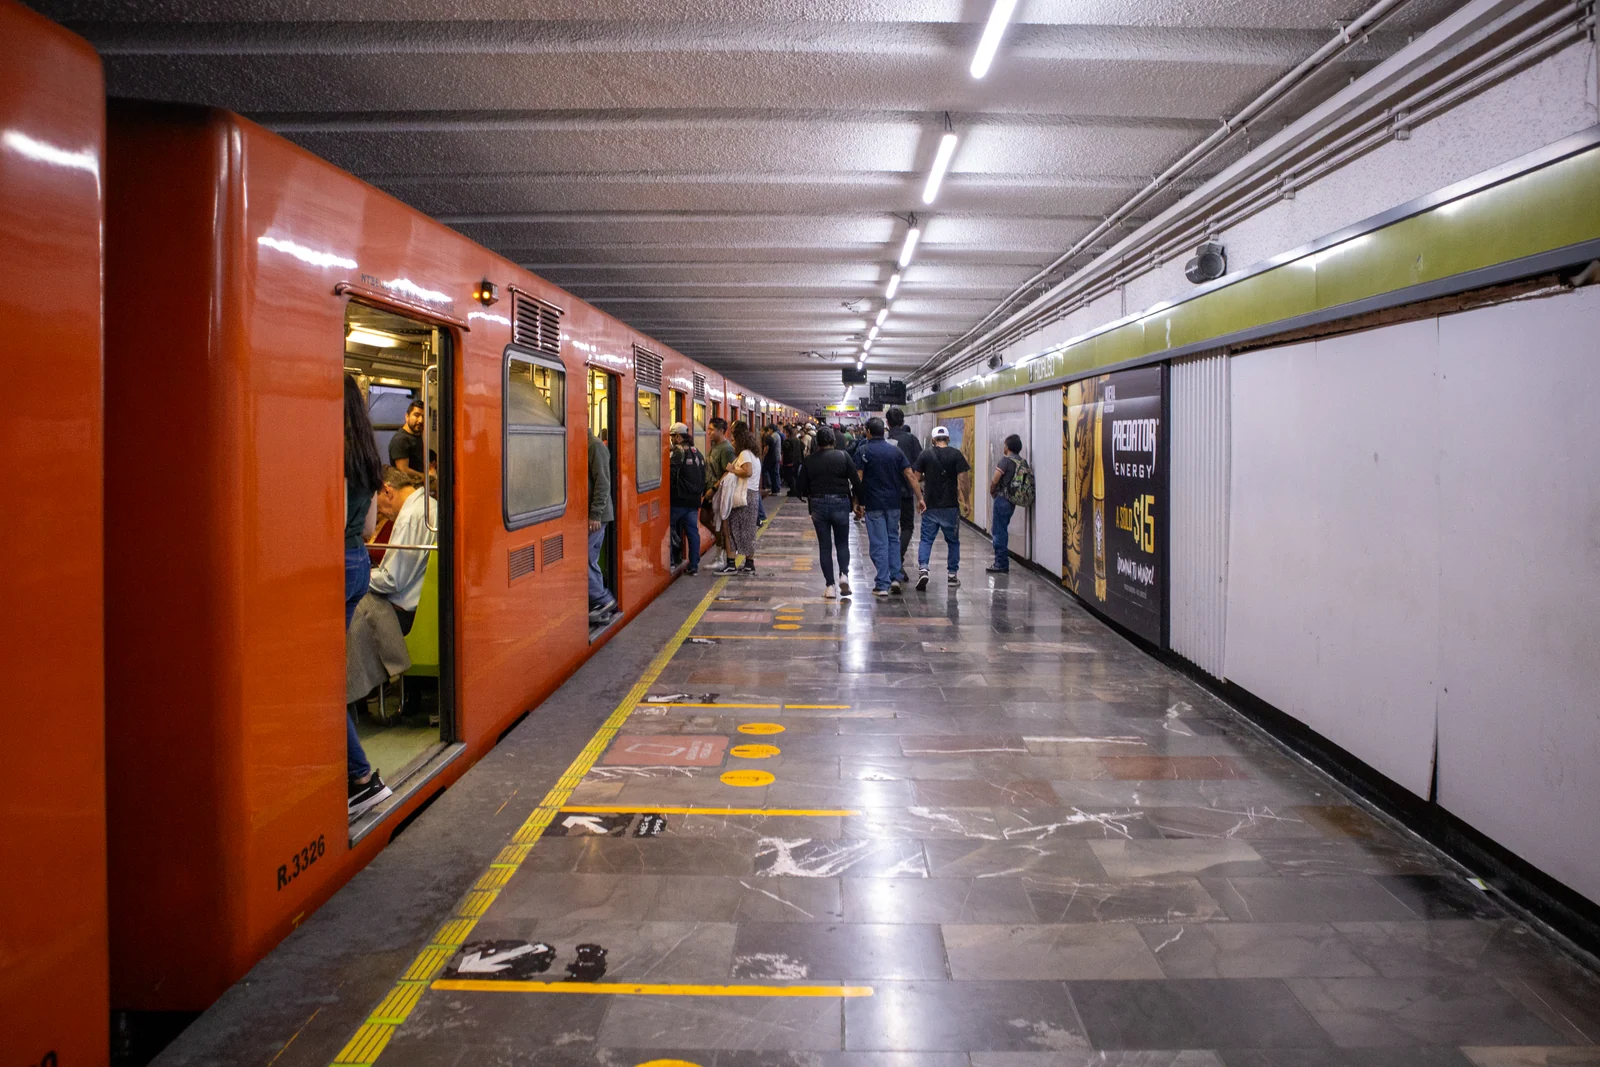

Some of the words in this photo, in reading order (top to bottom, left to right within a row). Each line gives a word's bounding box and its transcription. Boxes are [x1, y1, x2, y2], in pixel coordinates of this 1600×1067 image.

[1112, 418, 1156, 460] PREDATOR
[1115, 462, 1152, 479] ENERGY
[1133, 494, 1155, 554] $15
[277, 834, 325, 891] R.3326
